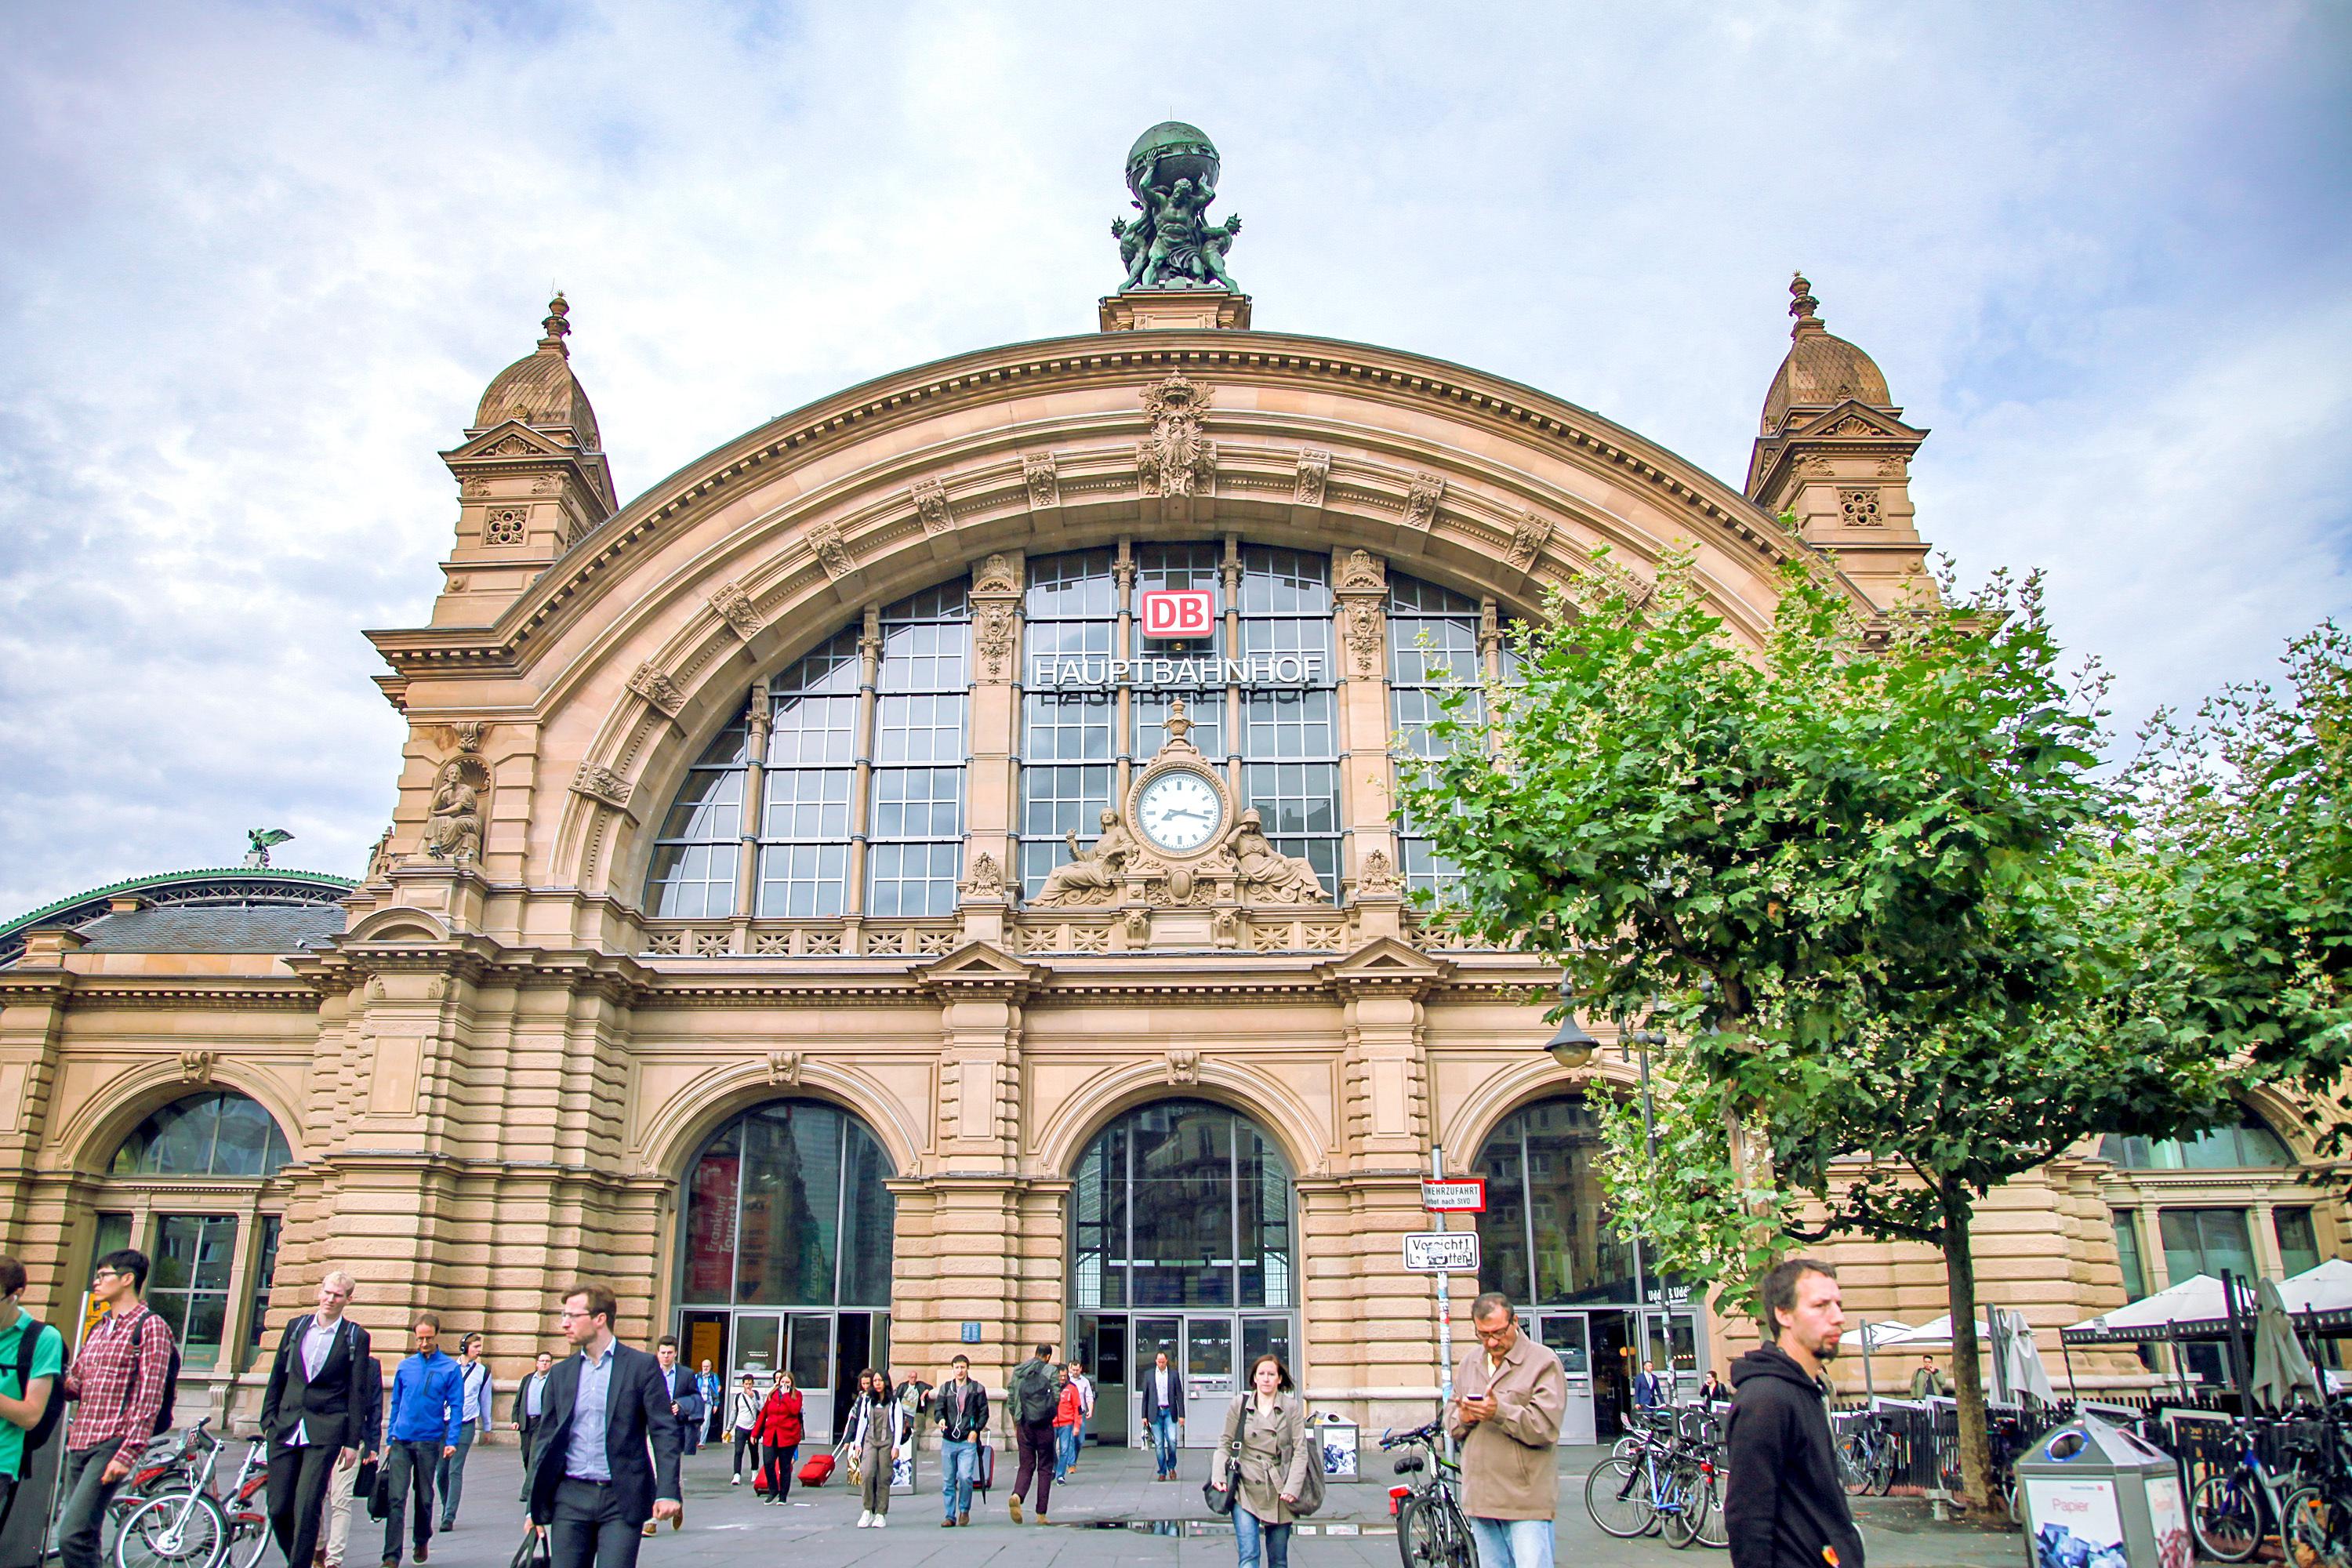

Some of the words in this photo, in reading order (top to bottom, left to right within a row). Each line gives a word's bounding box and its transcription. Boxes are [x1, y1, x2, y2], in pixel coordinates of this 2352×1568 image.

[1152, 598, 1203, 629] DB
[1035, 656, 1323, 685] HAUPTBAHNHOF
[706, 1195, 727, 1252] Frankfurt
[807, 1243, 821, 1299] Europcar
[1647, 1289, 1662, 1301] Udd
[2052, 1497, 2089, 1512] Papier
